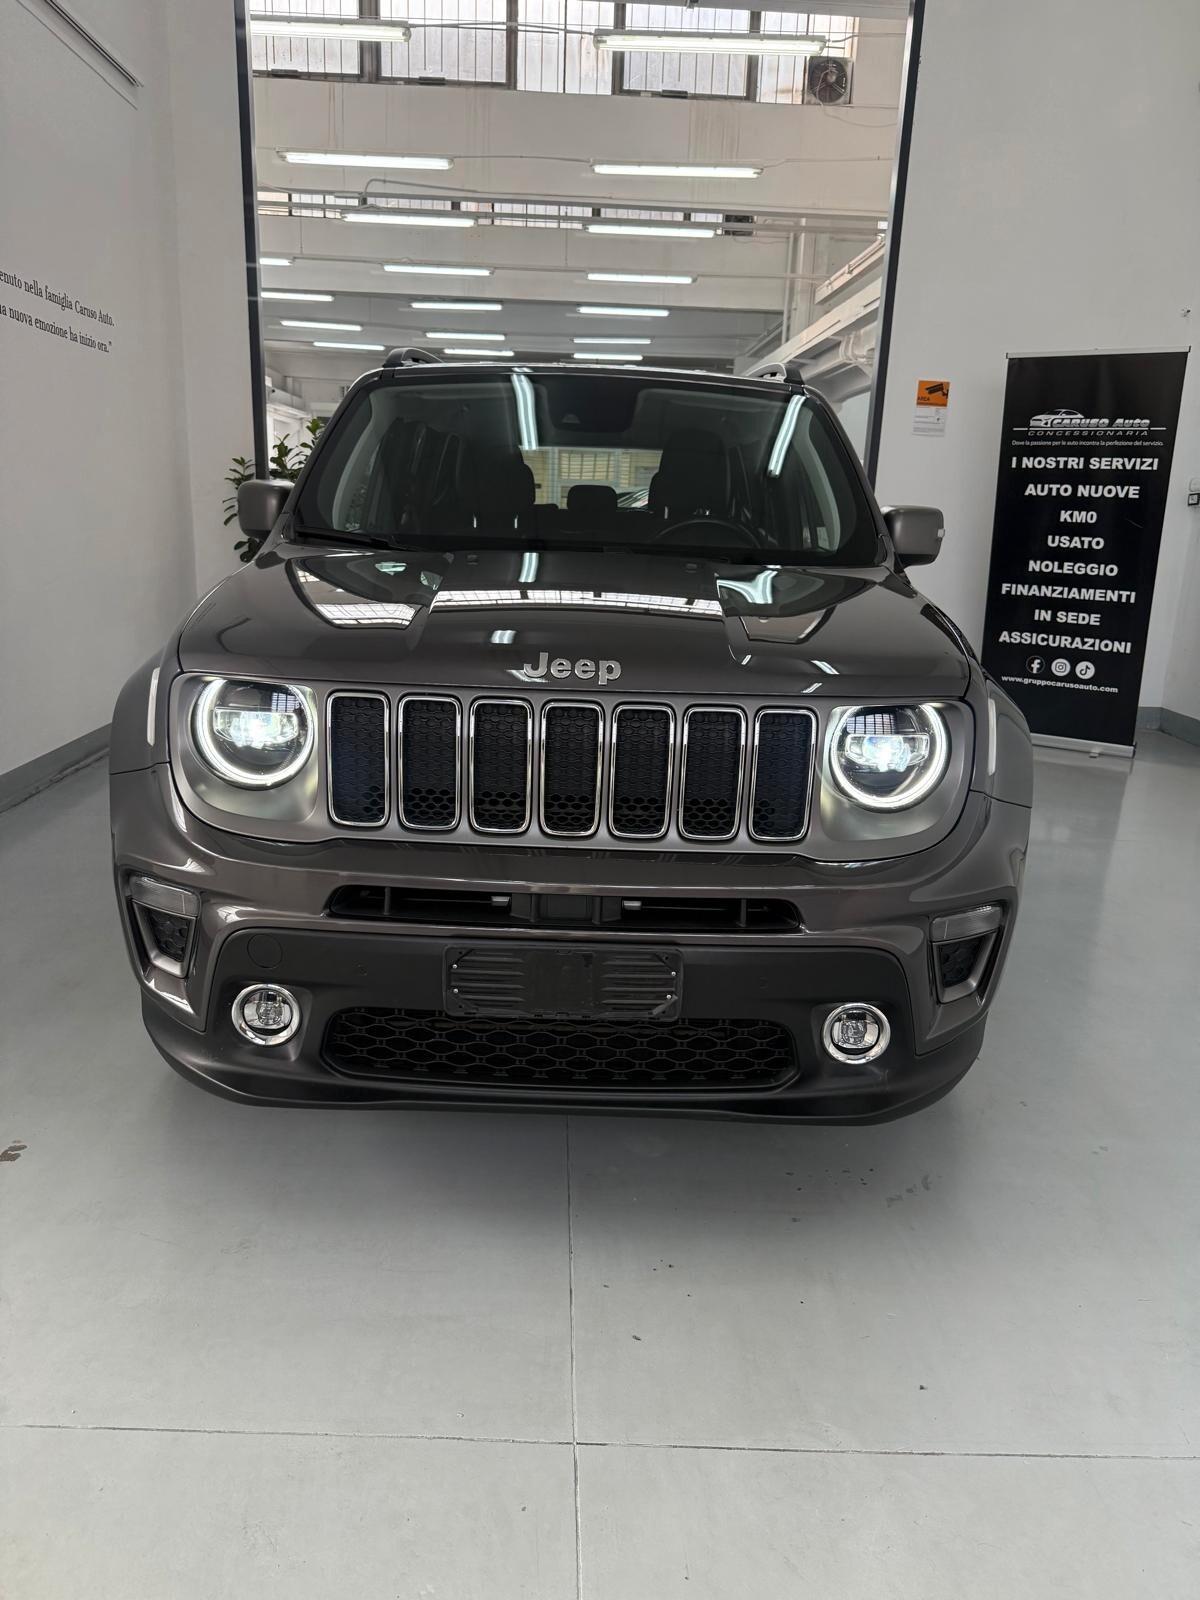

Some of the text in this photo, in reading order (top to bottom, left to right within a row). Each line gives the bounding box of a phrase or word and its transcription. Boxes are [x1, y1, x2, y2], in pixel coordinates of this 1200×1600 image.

[24, 279, 43, 298] nella
[45, 284, 73, 311] famiglia
[75, 300, 97, 320] Caruso
[9, 307, 33, 326] nuova
[35, 318, 68, 339] emozione
[69, 325, 78, 343] ha
[79, 331, 97, 349] inizio
[1052, 418, 1150, 428] CARUSO Auto
[1011, 457, 1159, 470] I NOSTRI SERVIZI
[1024, 484, 1140, 498] AUTO NUOVE
[1047, 535, 1105, 550] USATO
[1028, 560, 1119, 577] NOLEGGIO
[1001, 583, 1136, 603] FINANZIAMENTI
[1034, 609, 1101, 625] IN SEDE
[999, 631, 1132, 654] ASSICURAZIONI
[523, 652, 622, 685] Jeep
[1001, 675, 1119, 693] www.gruppocarusoauto.com
